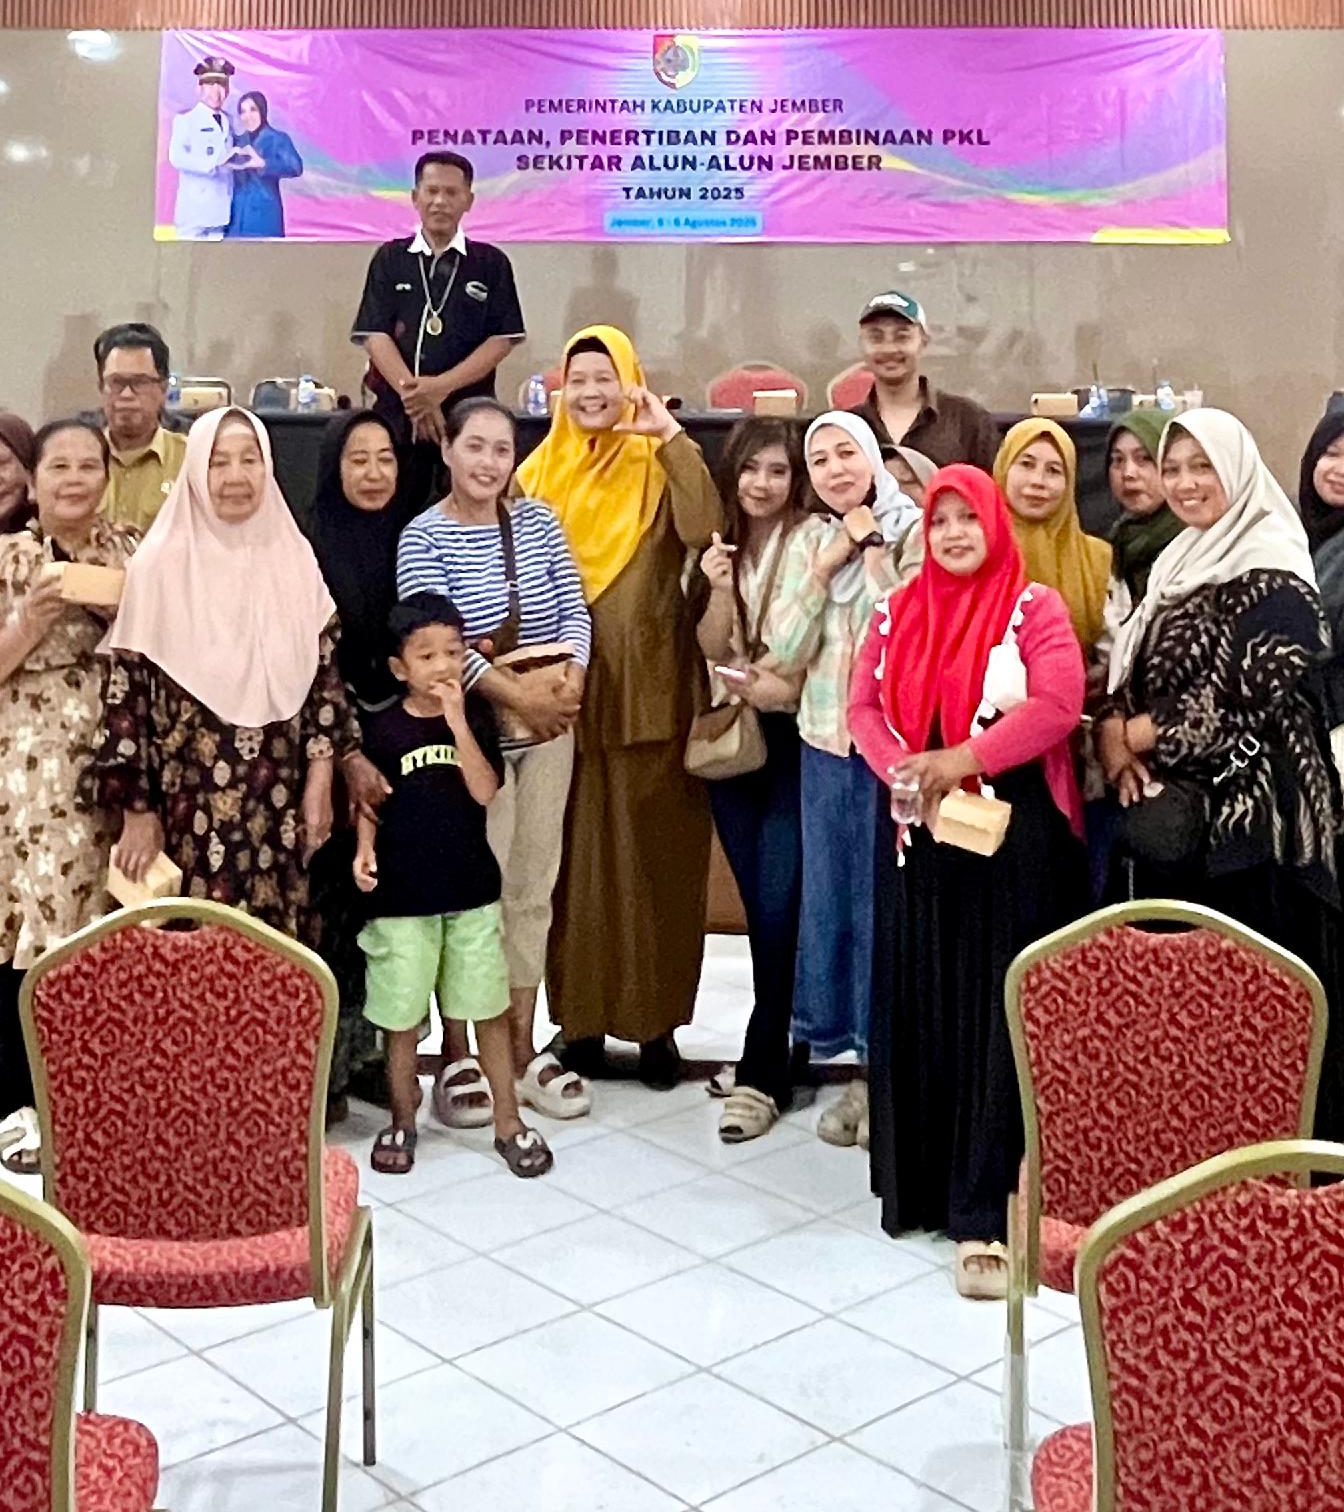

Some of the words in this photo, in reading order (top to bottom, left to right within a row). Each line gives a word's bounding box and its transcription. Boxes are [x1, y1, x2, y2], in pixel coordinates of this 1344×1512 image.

[524, 98, 645, 114] PEMERINTAH
[650, 98, 763, 114] KABUPATEN
[768, 98, 844, 114] JEMBER
[410, 128, 551, 149] PENATAAN,
[559, 128, 717, 146] PENERTIBAN
[725, 128, 777, 146] DAN
[784, 128, 934, 146] PEMBINAAN
[941, 128, 991, 146] PKL
[515, 154, 623, 172] SEKITAR
[630, 154, 774, 172] ALUN-ALUN
[780, 154, 883, 172] JEMBER
[622, 186, 692, 201] TAHUN
[698, 186, 746, 201] 2025
